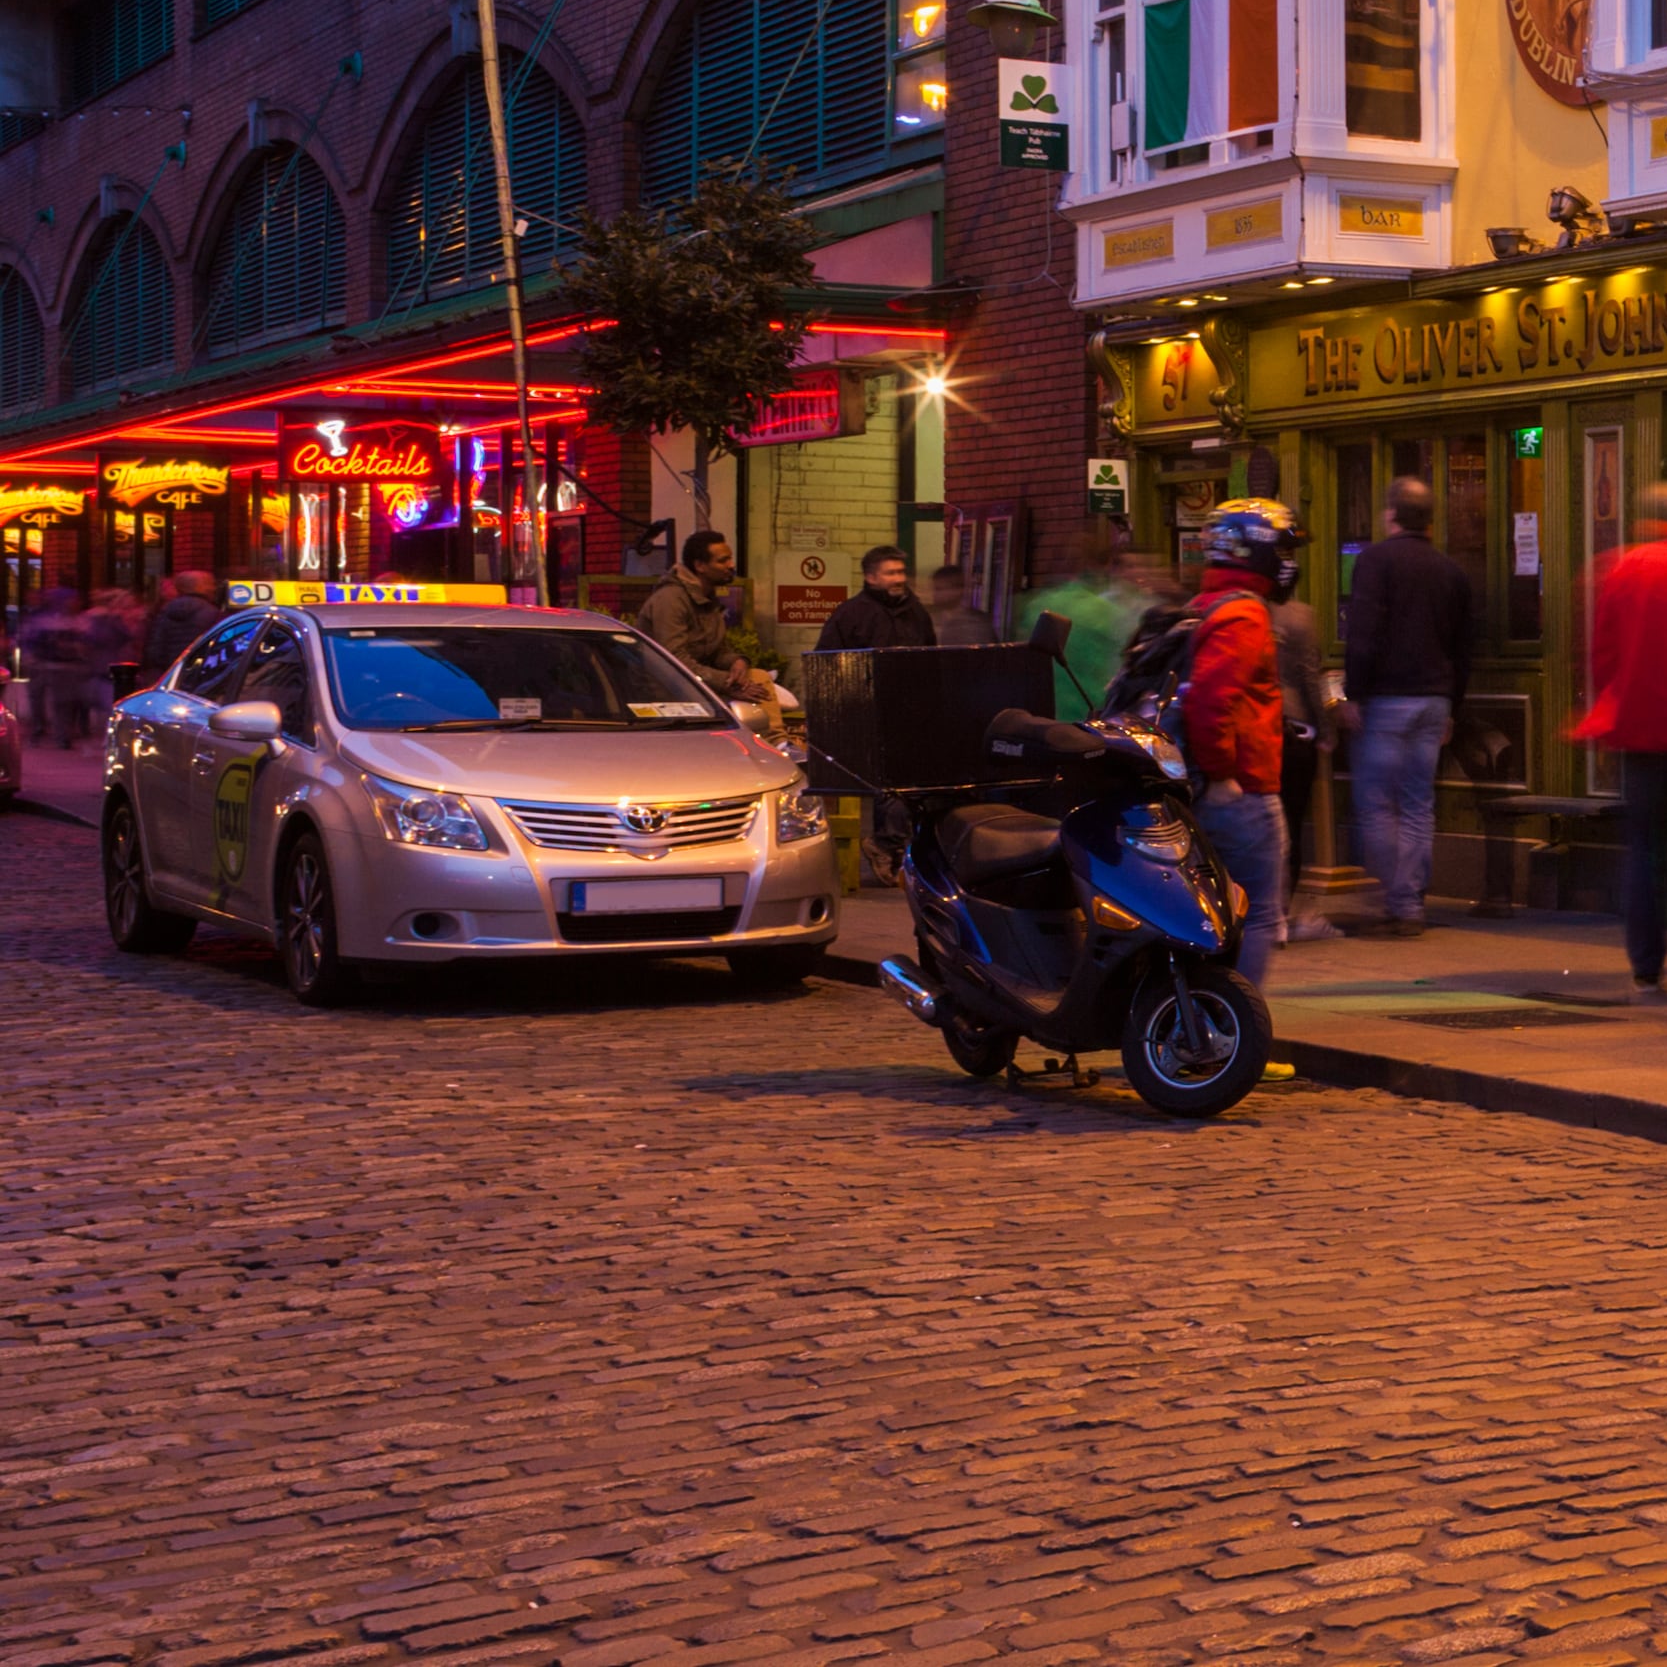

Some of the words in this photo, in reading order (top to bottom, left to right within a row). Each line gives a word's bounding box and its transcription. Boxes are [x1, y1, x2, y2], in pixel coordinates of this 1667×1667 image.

[1298, 324, 1362, 397] THE
[1373, 314, 1503, 386] OLIVER
[1162, 342, 1192, 411] 57
[293, 442, 431, 478] Cocktails
[156, 491, 203, 511] CAFE
[336, 583, 422, 602] TAXI
[806, 589, 821, 599] No
[789, 611, 803, 620] on
